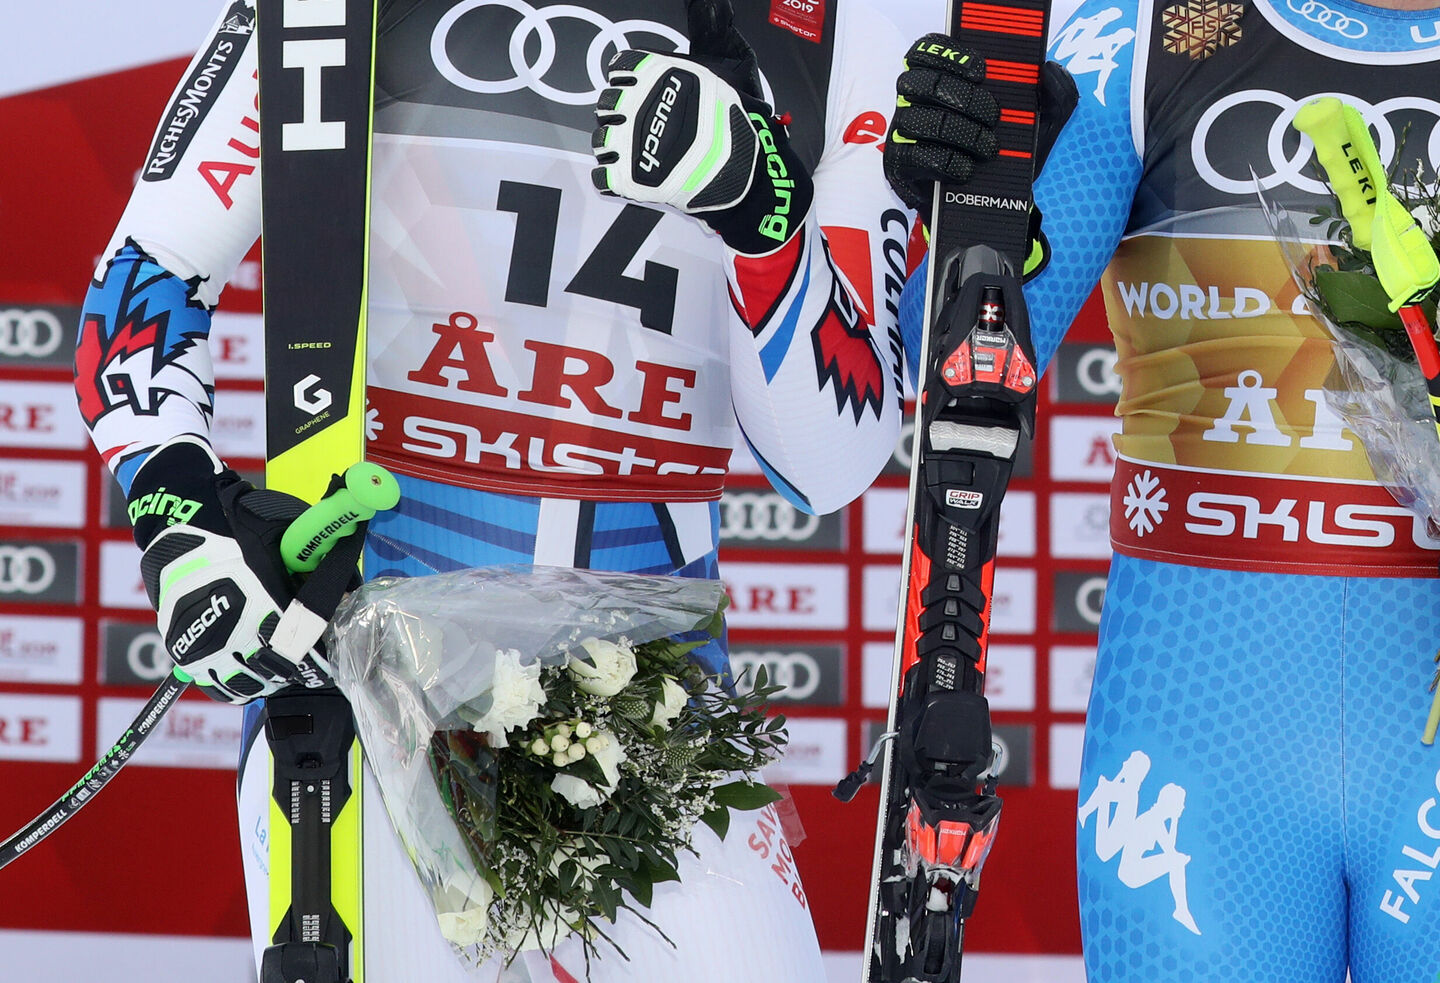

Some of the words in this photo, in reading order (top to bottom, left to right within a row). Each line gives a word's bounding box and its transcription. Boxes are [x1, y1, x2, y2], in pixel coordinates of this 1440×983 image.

[917, 40, 970, 65] LEKI
[197, 68, 260, 210] Au
[639, 76, 682, 173] reusch
[748, 112, 796, 242] racing
[1341, 141, 1377, 206] LEKI
[945, 191, 1028, 212] DOBERMANN
[496, 179, 680, 337] 14
[1117, 281, 1268, 320] WORLD
[407, 312, 697, 432] ÅRE
[295, 411, 330, 434] GRAPHENE
[127, 487, 204, 527] acing
[949, 490, 980, 500] GRIP
[296, 510, 360, 563] KOMPERDELL
[171, 594, 232, 661] reusch
[14, 809, 68, 854] KOMPERDELL
